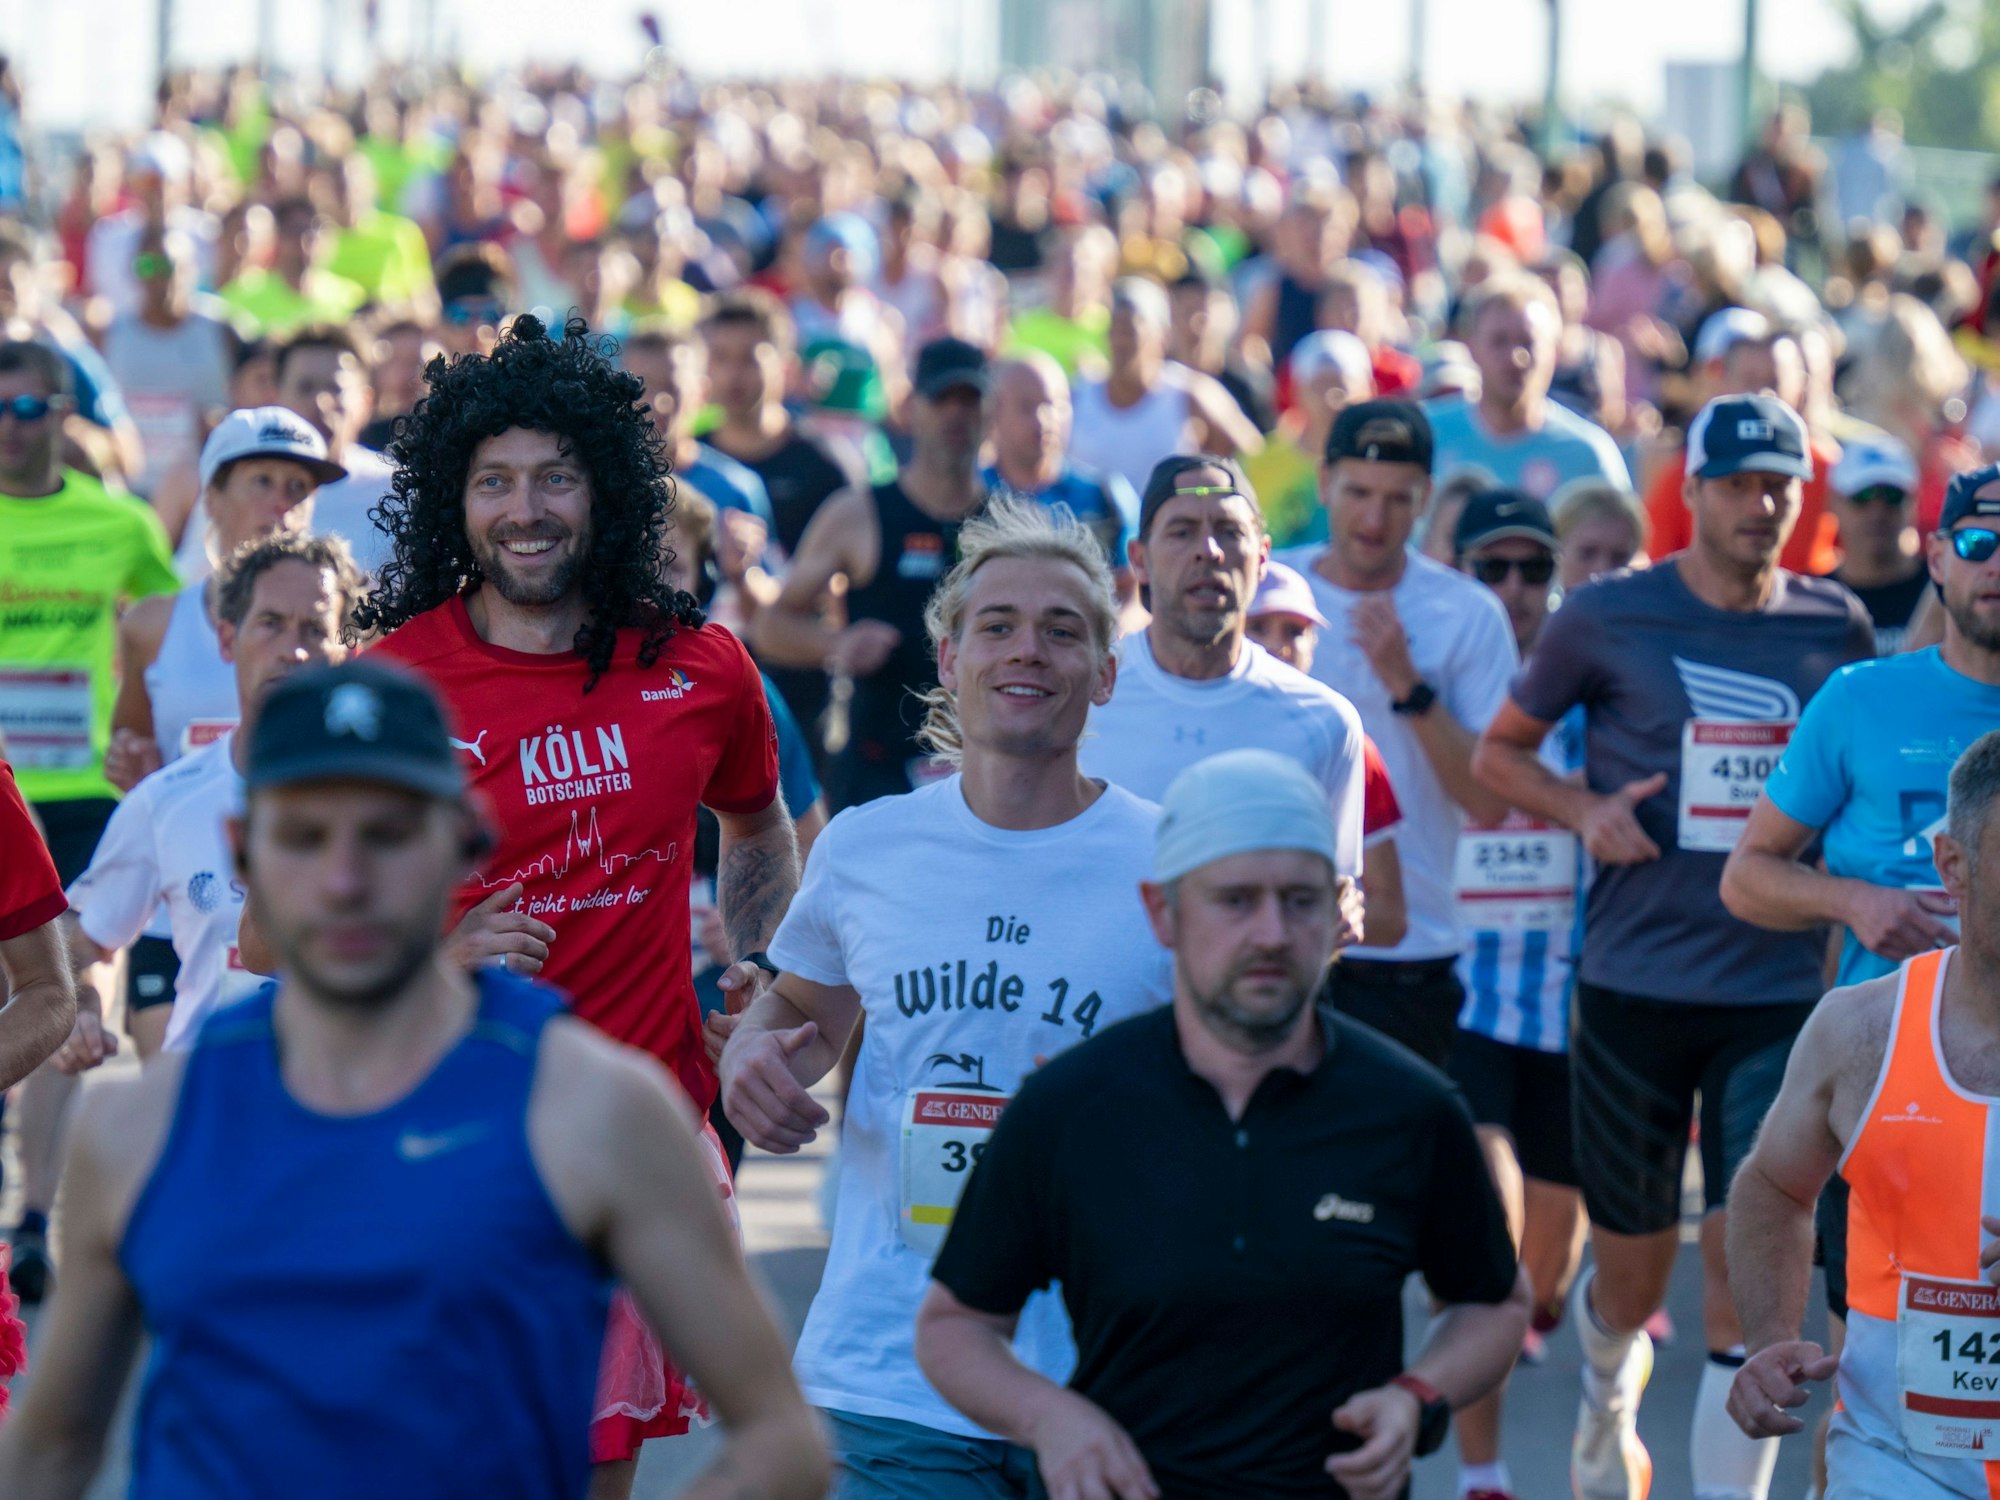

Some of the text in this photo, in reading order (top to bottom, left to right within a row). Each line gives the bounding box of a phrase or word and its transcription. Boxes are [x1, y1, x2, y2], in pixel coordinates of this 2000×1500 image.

[641, 687, 684, 702] Daniel
[519, 723, 629, 786] KÖLN
[1711, 755, 1779, 783] 430
[525, 772, 632, 806] BOTSCHAFTER
[570, 887, 624, 912] widder
[985, 915, 1030, 945] Die
[893, 959, 1103, 1039] Wilde 14
[1953, 1370, 1999, 1391] Kev
